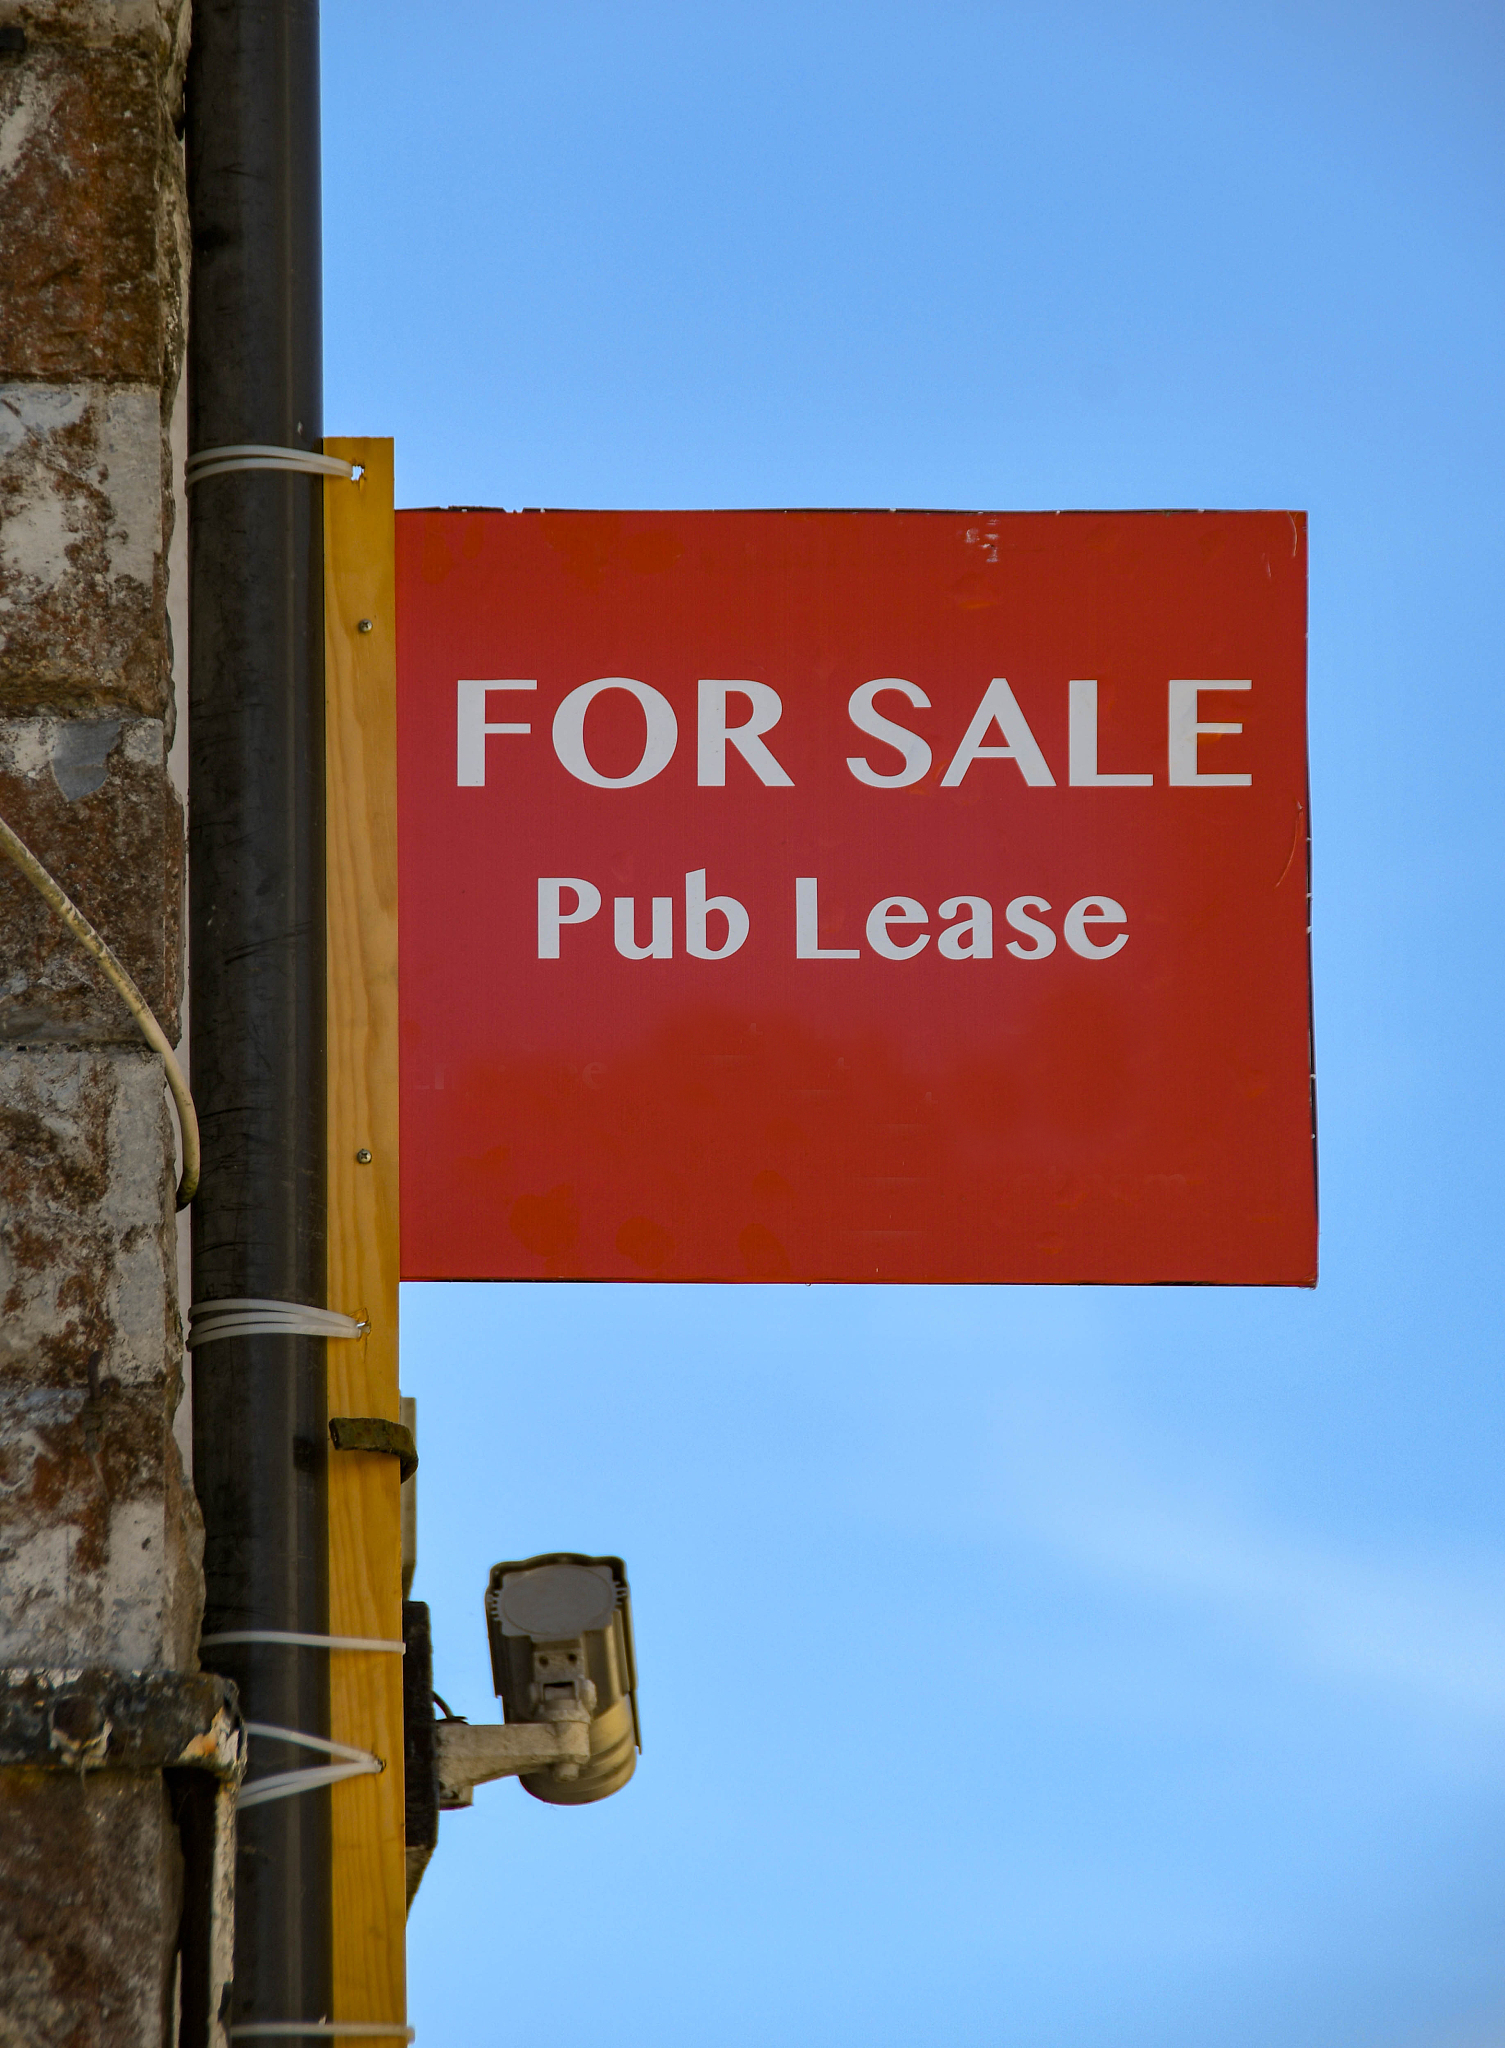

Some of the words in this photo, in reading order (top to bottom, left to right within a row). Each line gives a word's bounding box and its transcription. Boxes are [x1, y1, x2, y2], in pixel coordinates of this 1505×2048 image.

[457, 678, 796, 789] FOR
[847, 678, 1253, 789] SALE
[537, 868, 750, 961] Pub
[796, 878, 1130, 961] Lease
